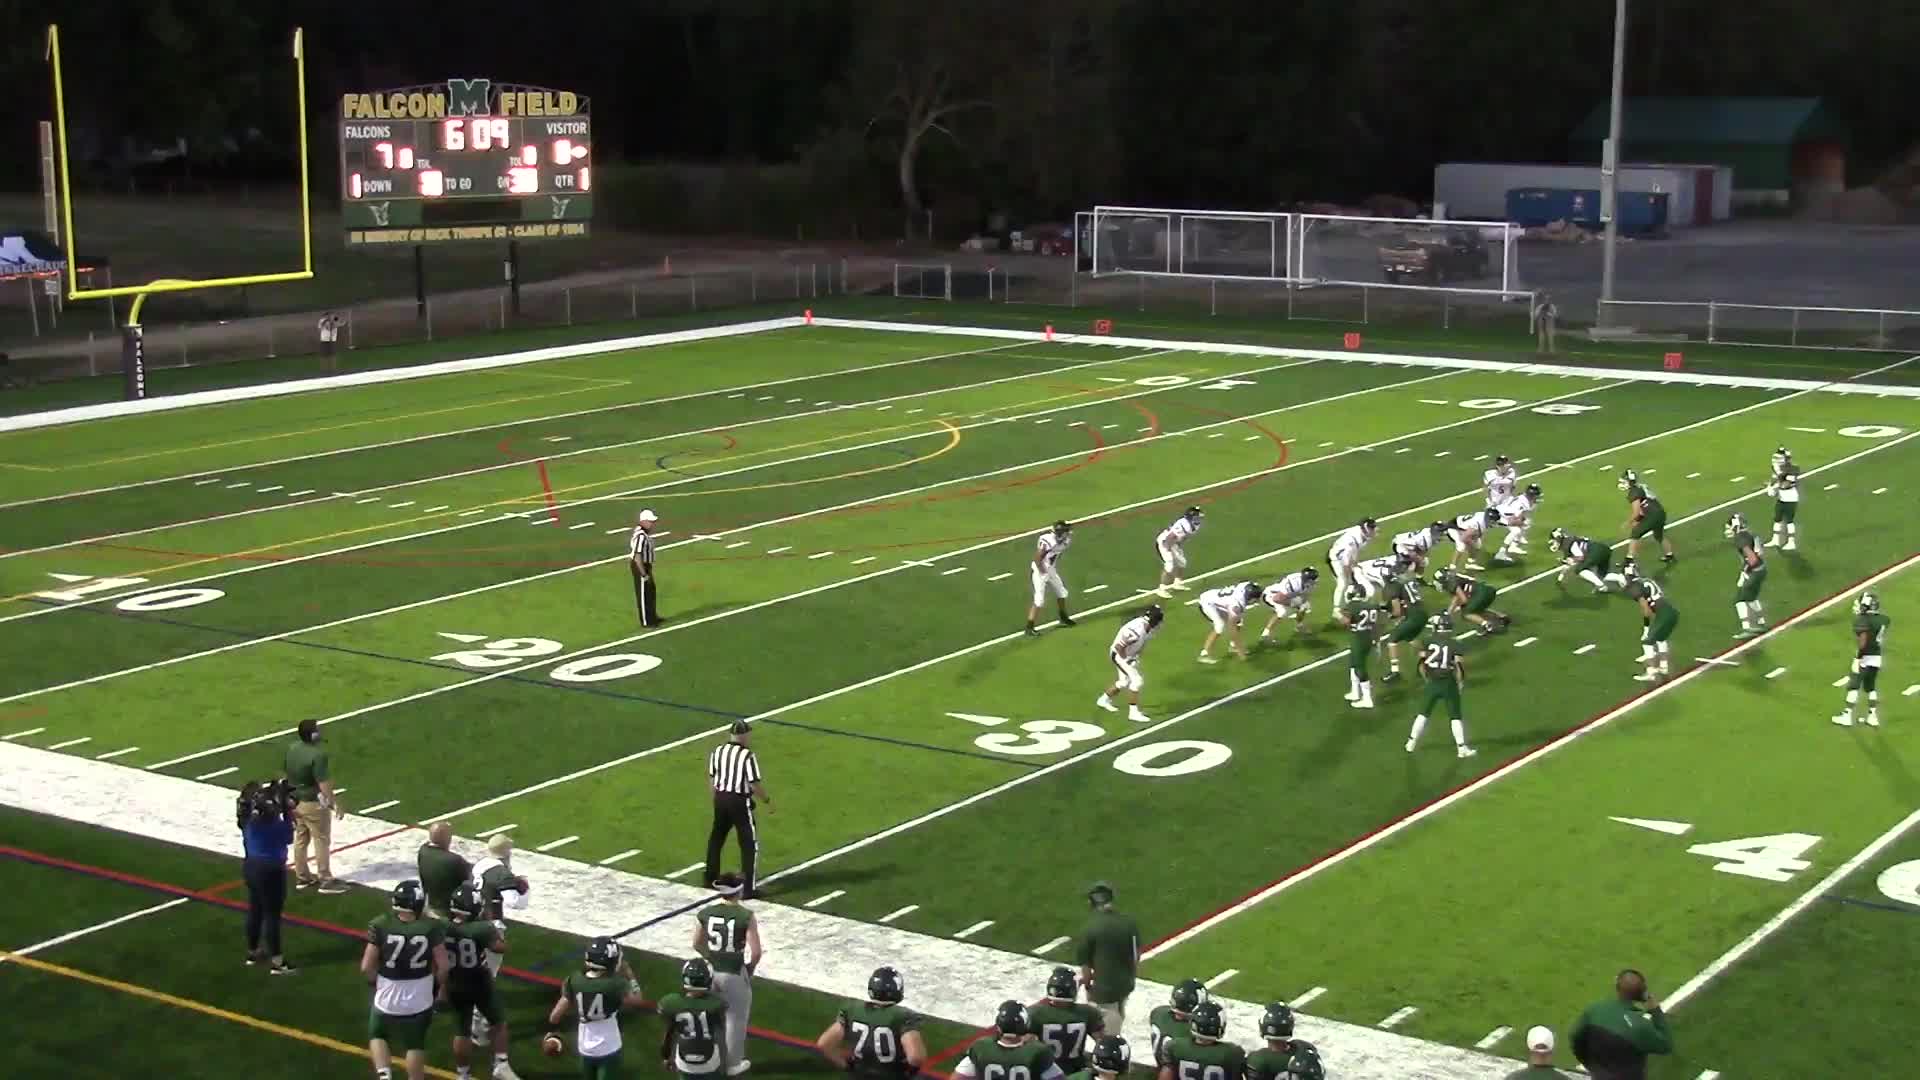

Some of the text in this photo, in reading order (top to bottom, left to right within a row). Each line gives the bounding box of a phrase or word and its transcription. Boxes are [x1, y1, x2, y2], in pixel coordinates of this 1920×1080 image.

[344, 91, 577, 118] FALCON FIELD
[448, 79, 489, 117] M
[345, 126, 391, 138] FALCONS
[546, 122, 587, 135] VISITOR
[375, 143, 394, 169] 7
[352, 174, 362, 198] 1
[363, 180, 392, 193] DOWN
[446, 177, 457, 190] TO
[460, 177, 472, 190] GO
[555, 174, 574, 188] QTR
[136, 341, 144, 398] FALCONS
[1424, 643, 1449, 669] 21
[706, 916, 736, 953] 51
[385, 933, 430, 969] 72
[575, 991, 607, 1023] 14
[674, 1010, 713, 1040] 31
[852, 1020, 897, 1063] 70
[1042, 1022, 1086, 1058] 57
